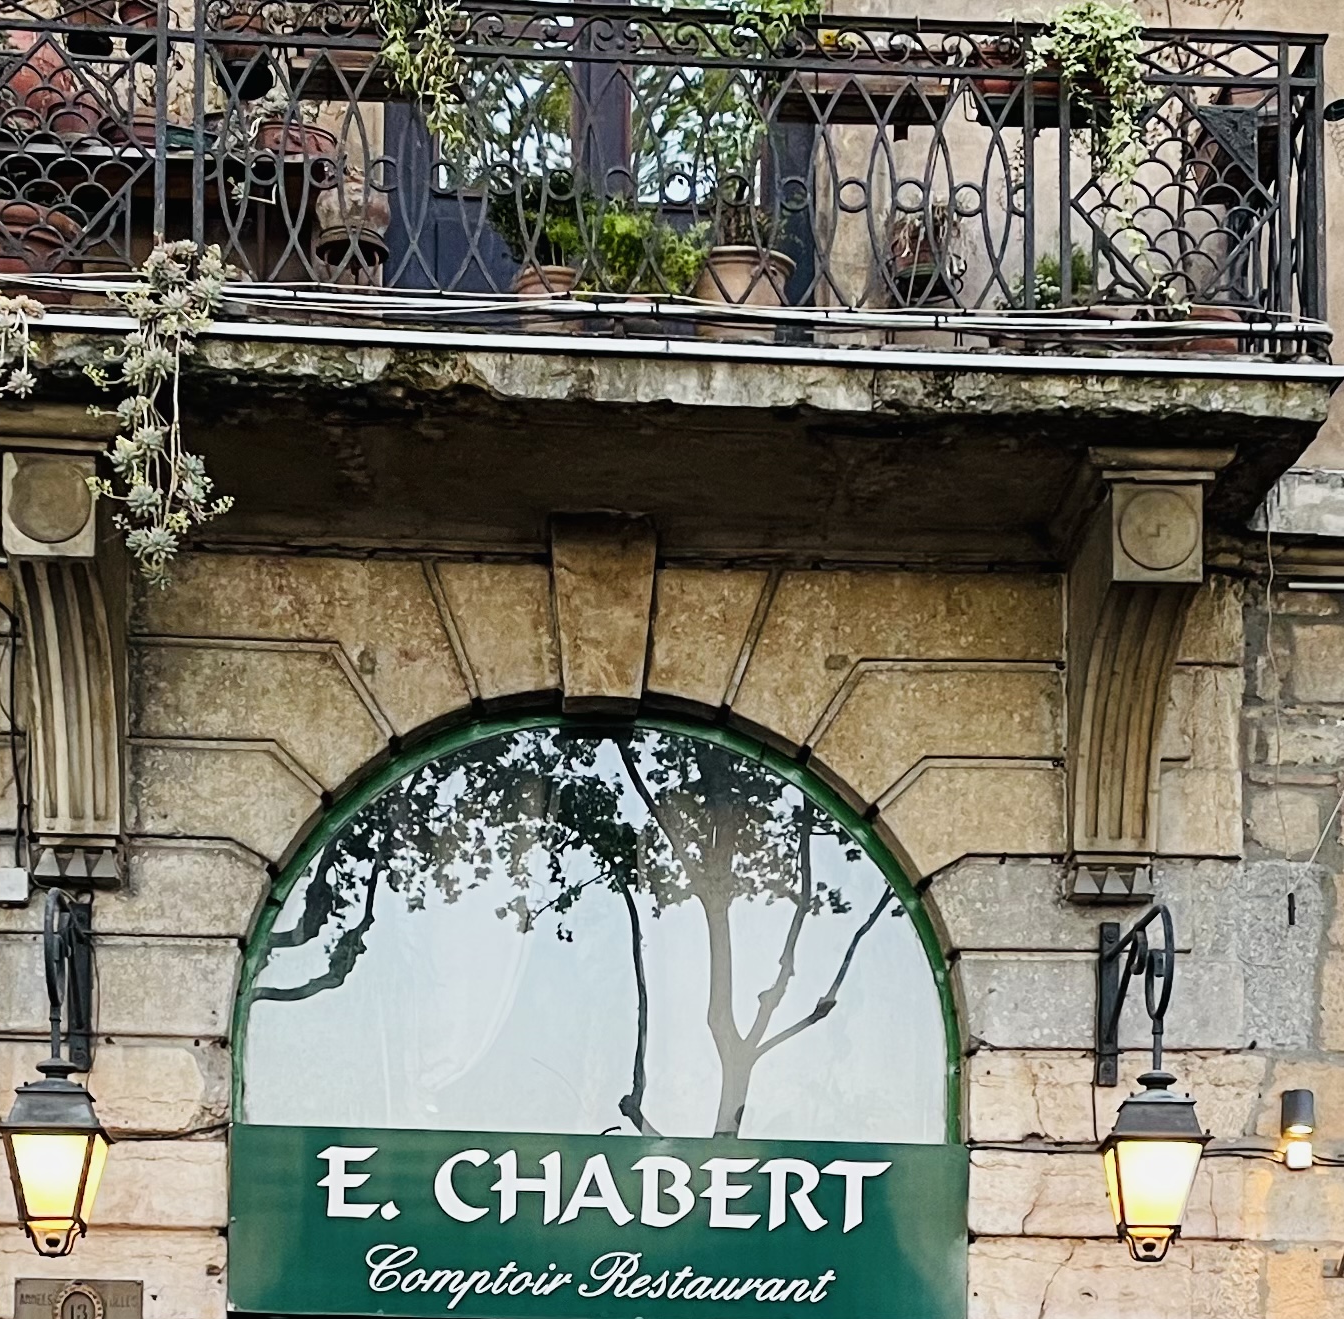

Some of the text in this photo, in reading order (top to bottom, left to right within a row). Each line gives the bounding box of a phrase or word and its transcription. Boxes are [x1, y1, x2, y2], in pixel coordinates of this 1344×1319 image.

[315, 1145, 894, 1234] E. CHABERT
[364, 1243, 836, 1310] Comptoir Restaurant
